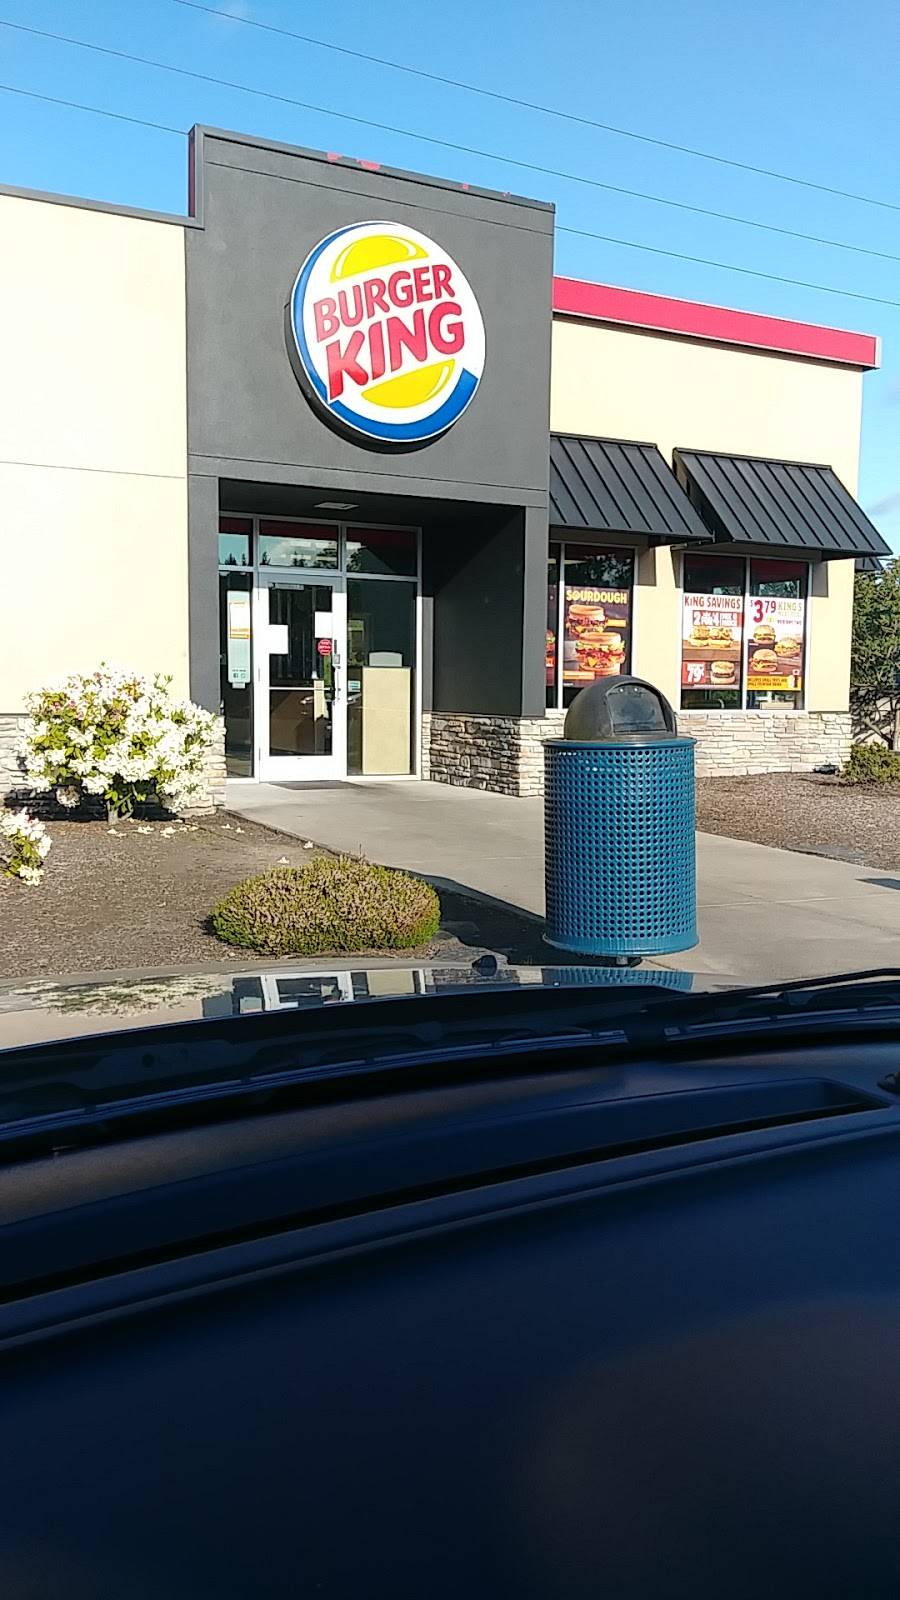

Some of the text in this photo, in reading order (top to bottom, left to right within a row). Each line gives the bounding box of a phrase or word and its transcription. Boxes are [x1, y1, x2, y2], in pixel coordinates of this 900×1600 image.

[313, 264, 455, 343] BURGER
[326, 301, 465, 400] KING
[566, 590, 628, 604] SOURDOUGH
[707, 596, 741, 609] SAVINGS
